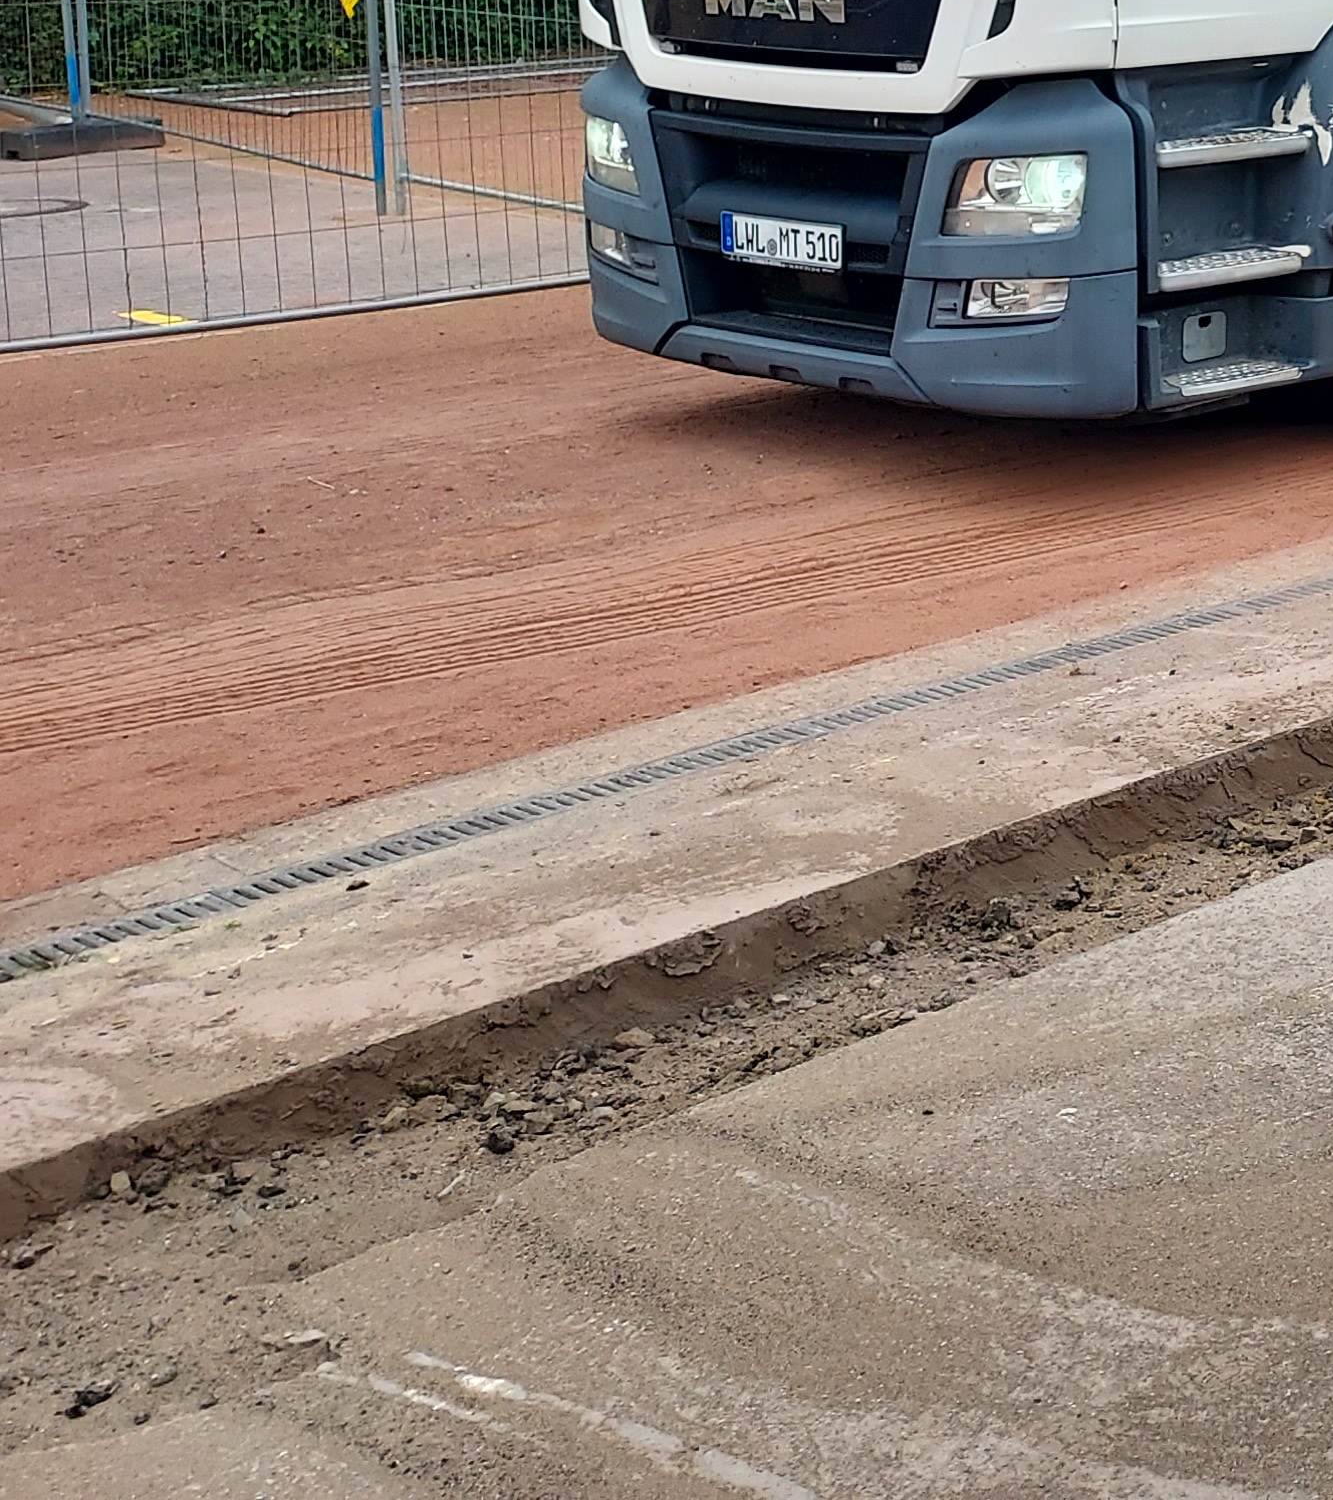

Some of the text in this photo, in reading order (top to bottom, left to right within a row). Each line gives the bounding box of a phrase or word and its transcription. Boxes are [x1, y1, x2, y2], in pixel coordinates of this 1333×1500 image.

[735, 220, 839, 262] LWL MT 510
